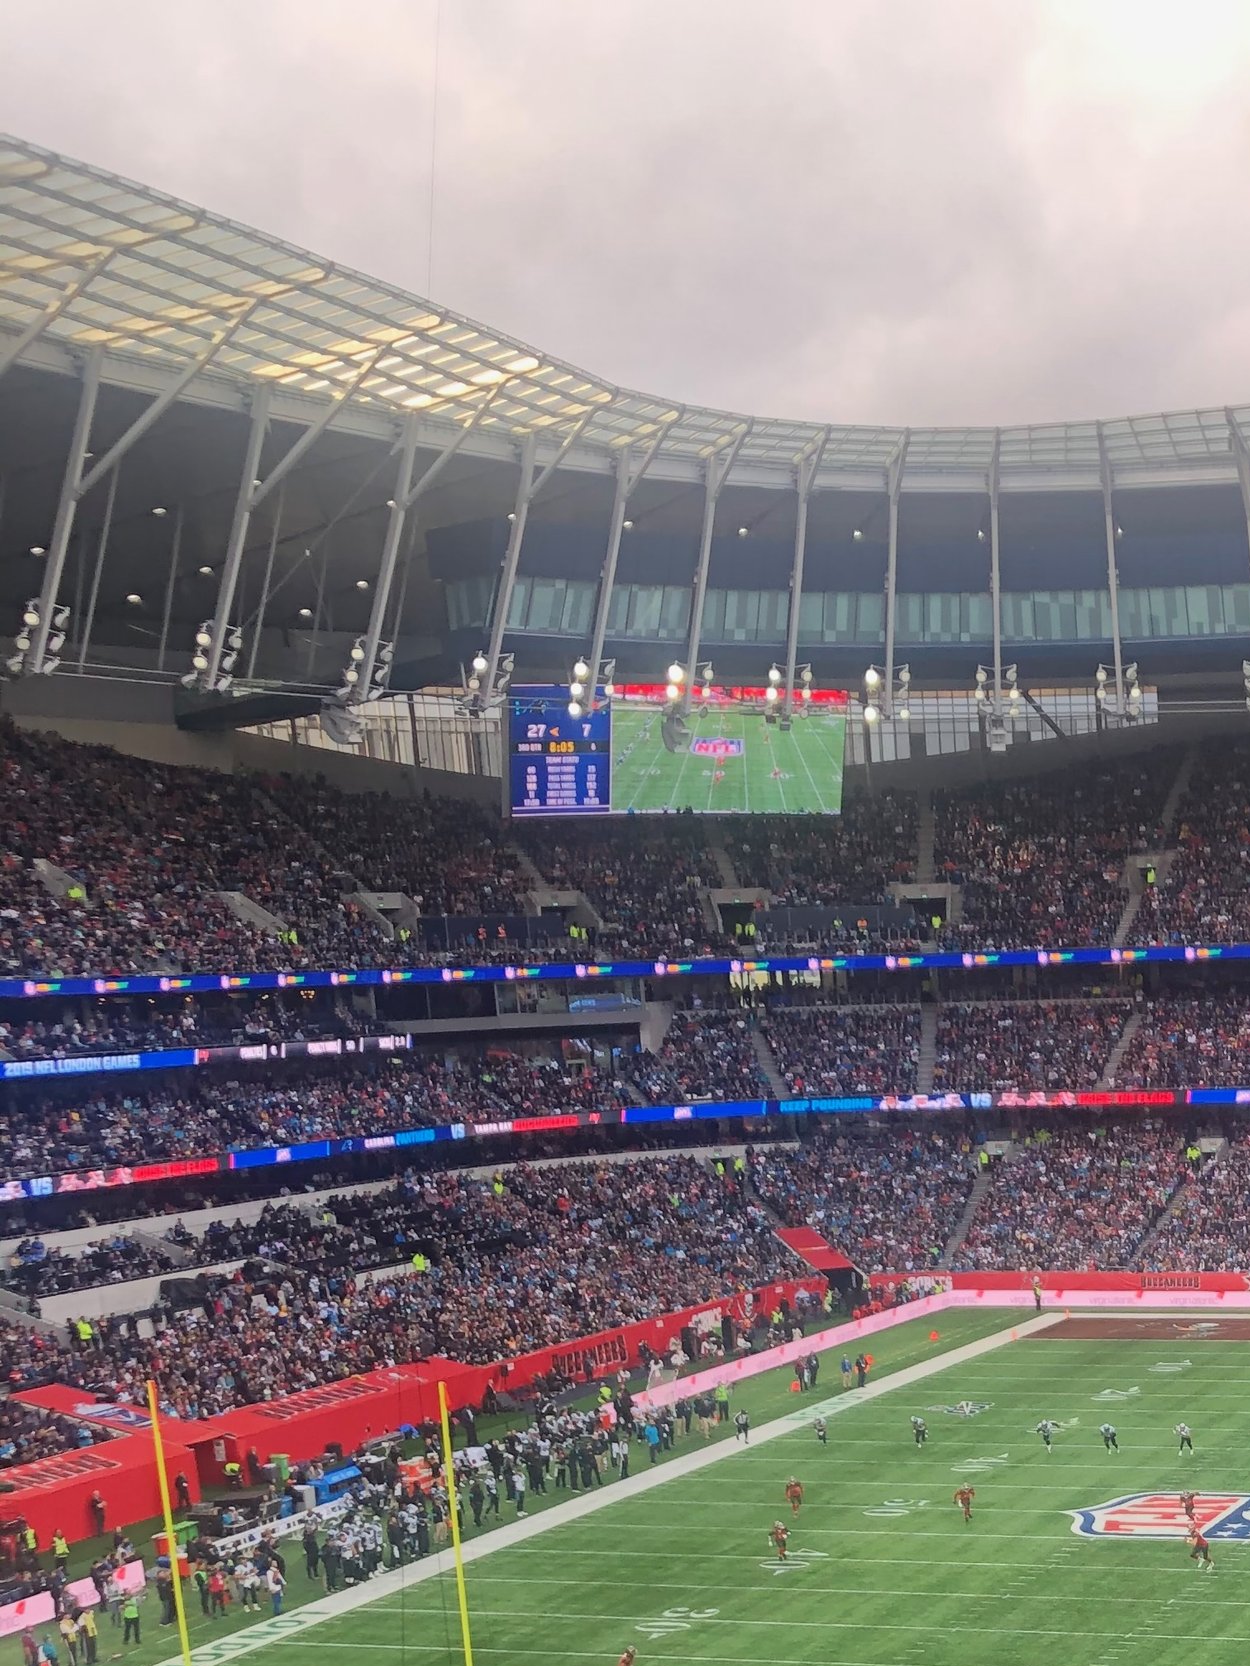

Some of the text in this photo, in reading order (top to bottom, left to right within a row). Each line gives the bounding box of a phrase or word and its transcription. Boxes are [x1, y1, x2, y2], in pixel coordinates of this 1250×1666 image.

[527, 723, 592, 738] 27 7
[549, 741, 575, 753] 8:05
[4, 1054, 140, 1077] 2019 NFL LONDON GAMES
[780, 1098, 872, 1113] KEEP POUNDING
[970, 1093, 992, 1107] VS
[450, 1123, 465, 1140] VS
[475, 1123, 499, 1135] TAMPA
[499, 1121, 513, 1133] BAY
[31, 1177, 53, 1196] VS
[1140, 1275, 1201, 1290] BUCCANEERS
[633, 1605, 721, 1634] 30
